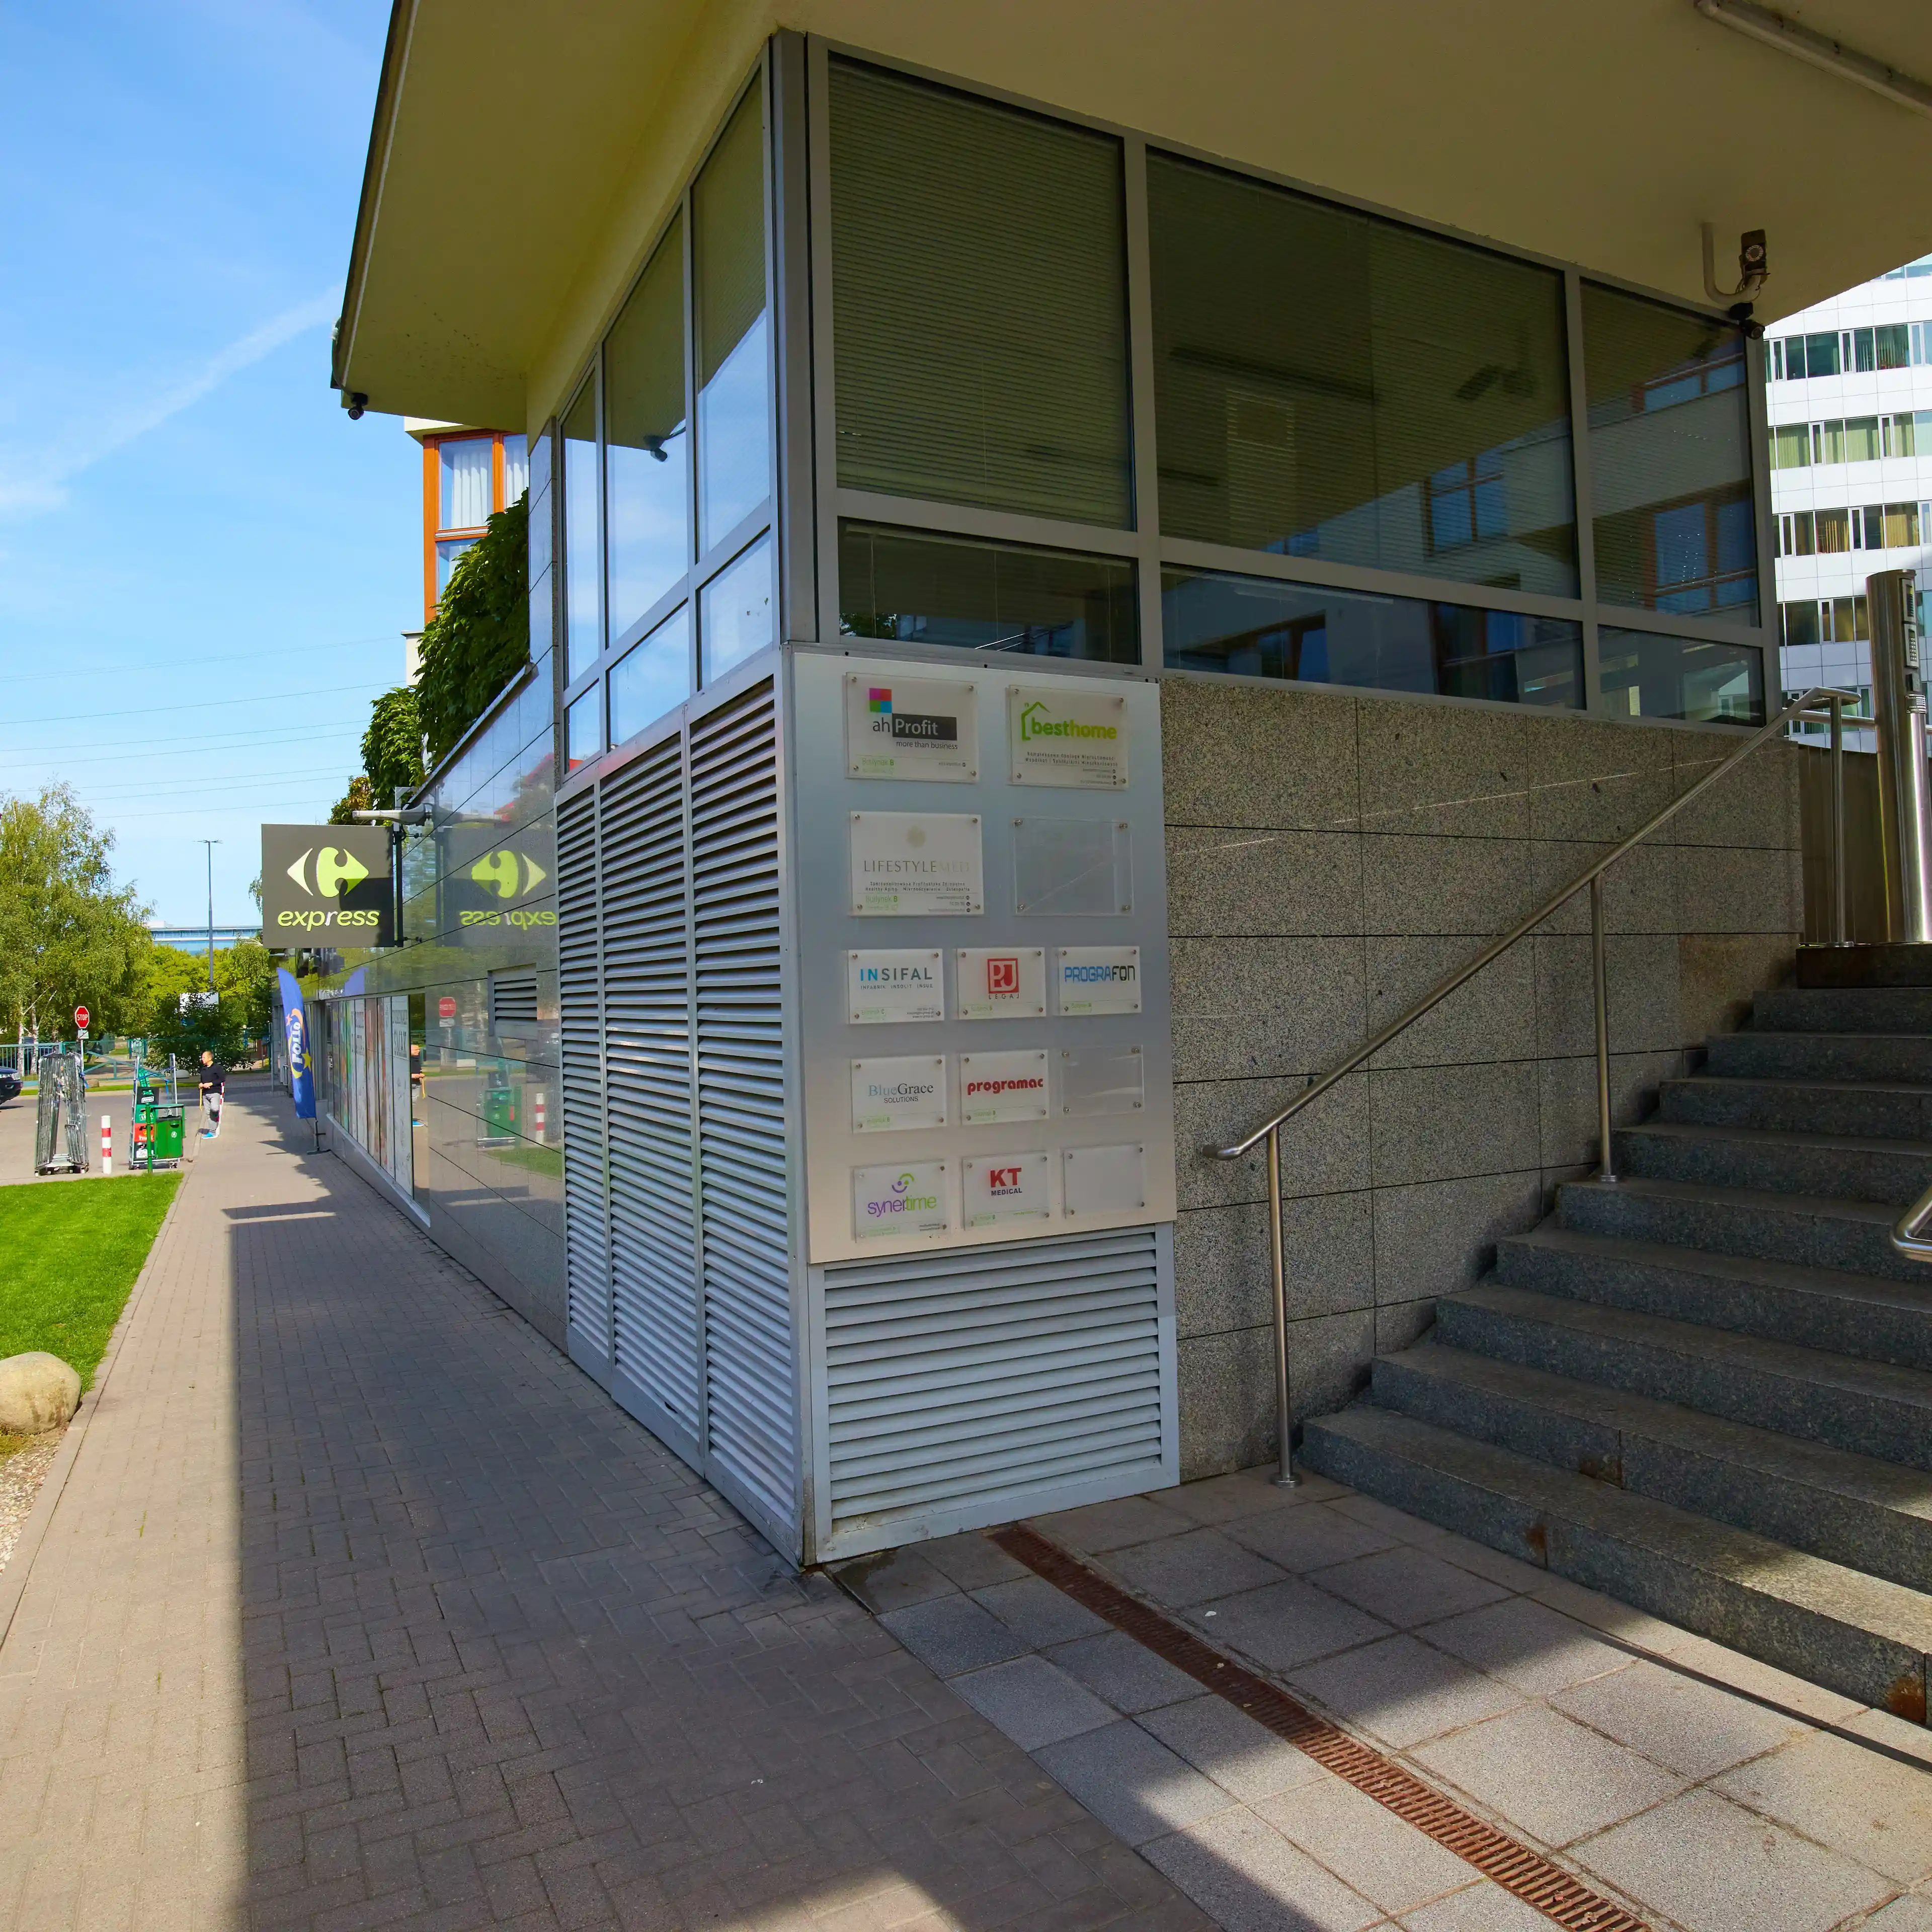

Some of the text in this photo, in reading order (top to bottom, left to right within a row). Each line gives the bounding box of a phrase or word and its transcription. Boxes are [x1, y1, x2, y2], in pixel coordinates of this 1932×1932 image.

[1031, 716, 1117, 739] besthome
[914, 741, 929, 749] than
[931, 742, 958, 750] business
[277, 909, 380, 932] express
[860, 967, 933, 981] INSIFAL
[1065, 965, 1135, 983] PROGRAFON
[868, 1083, 934, 1097] BlueGrace
[967, 1078, 1043, 1096] programac
[990, 1167, 1022, 1188] KT
[991, 1188, 1023, 1196] MEDICAL
[867, 1195, 937, 1218] synertime
